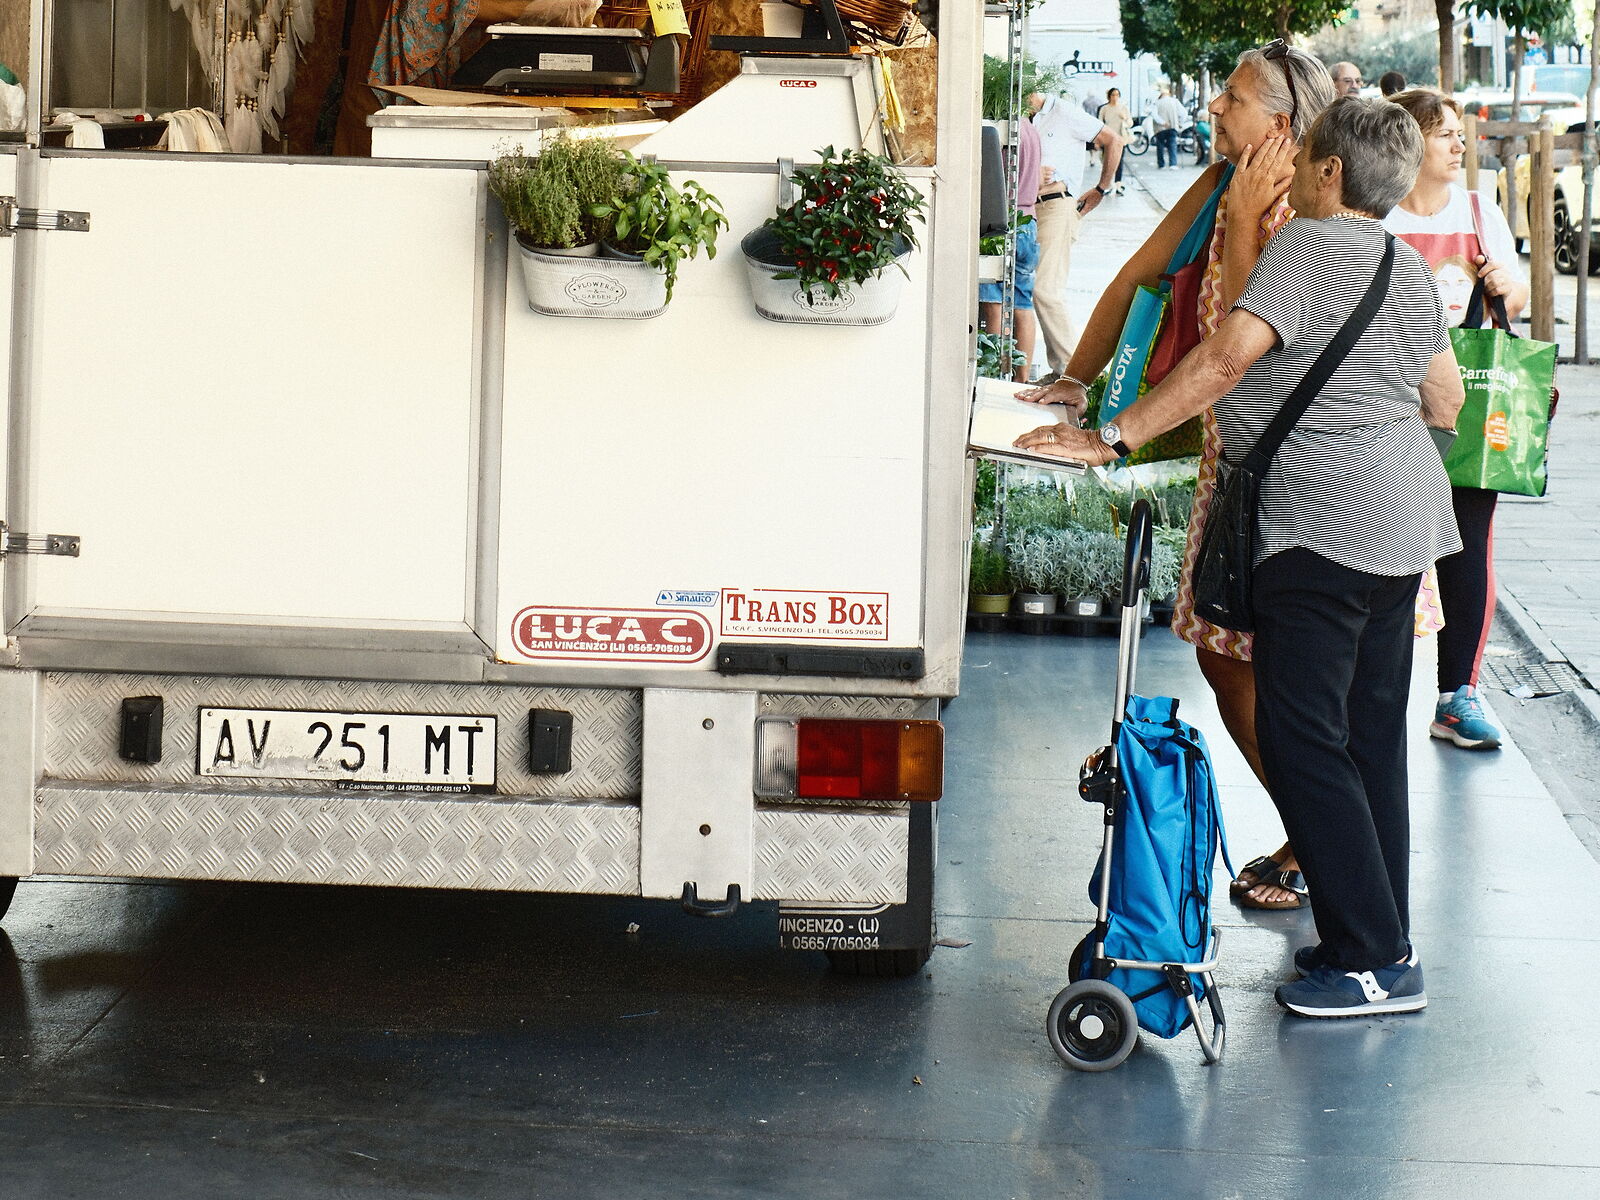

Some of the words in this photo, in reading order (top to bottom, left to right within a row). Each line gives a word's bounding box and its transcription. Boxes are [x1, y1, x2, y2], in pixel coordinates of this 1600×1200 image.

[577, 281, 616, 291] FLOWERS
[531, 615, 646, 642] LUCA
[661, 619, 692, 643] C.
[531, 641, 552, 649] SAN
[554, 641, 607, 651] VINCENZO
[610, 642, 625, 652] (LI)
[212, 718, 271, 769] AV
[308, 721, 390, 774] 251
[425, 725, 483, 775] MT
[858, 917, 880, 933] (LI)
[792, 936, 880, 950] 0565/705034
